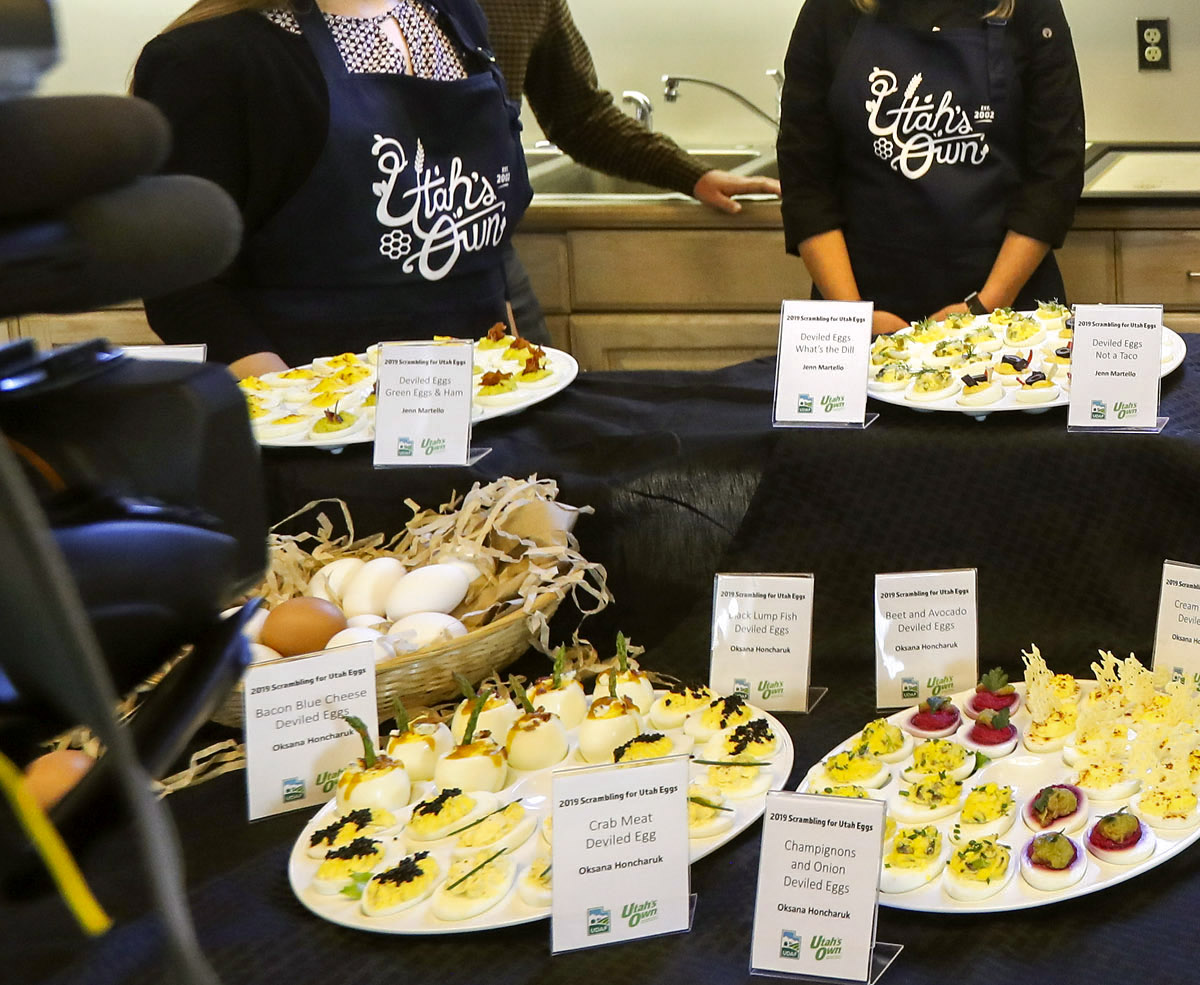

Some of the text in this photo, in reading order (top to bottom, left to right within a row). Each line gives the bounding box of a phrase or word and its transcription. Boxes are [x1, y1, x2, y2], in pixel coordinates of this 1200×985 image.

[974, 111, 994, 119] 2002
[801, 333, 851, 343] Deviled Eggs
[1093, 339, 1142, 349] Deviled Eggs
[842, 346, 854, 354] Dill
[400, 376, 451, 385] Deviled Eggs
[414, 389, 431, 397] Eggs
[1175, 600, 1199, 611] Cream
[729, 611, 797, 622] ack Lump Fish
[886, 608, 966, 619] Beet and Avocado
[735, 624, 789, 636] Deviled Eggs
[898, 623, 955, 632] Deviled Eggs
[1172, 634, 1192, 643] Oksana
[256, 689, 367, 718] Bacon Blue Cheese
[275, 707, 349, 730] Deviled Eggs
[272, 729, 354, 751] Oksana Honcharuk
[559, 785, 677, 808] 2019 Scrambling for Utah Eggs
[589, 813, 652, 831] Crab Meat
[770, 813, 873, 832] 2019 Scrambling for Utah Eggs
[586, 830, 656, 849] Deviled Egg
[785, 840, 856, 858] Champignons
[578, 855, 663, 875] Oksana Honcharuk
[791, 860, 845, 875] and Onion
[784, 876, 850, 895] Deviled Eggs
[777, 903, 850, 919] Oksana Honcharuk
[810, 935, 842, 949] Utah's
[815, 946, 841, 960] Own
